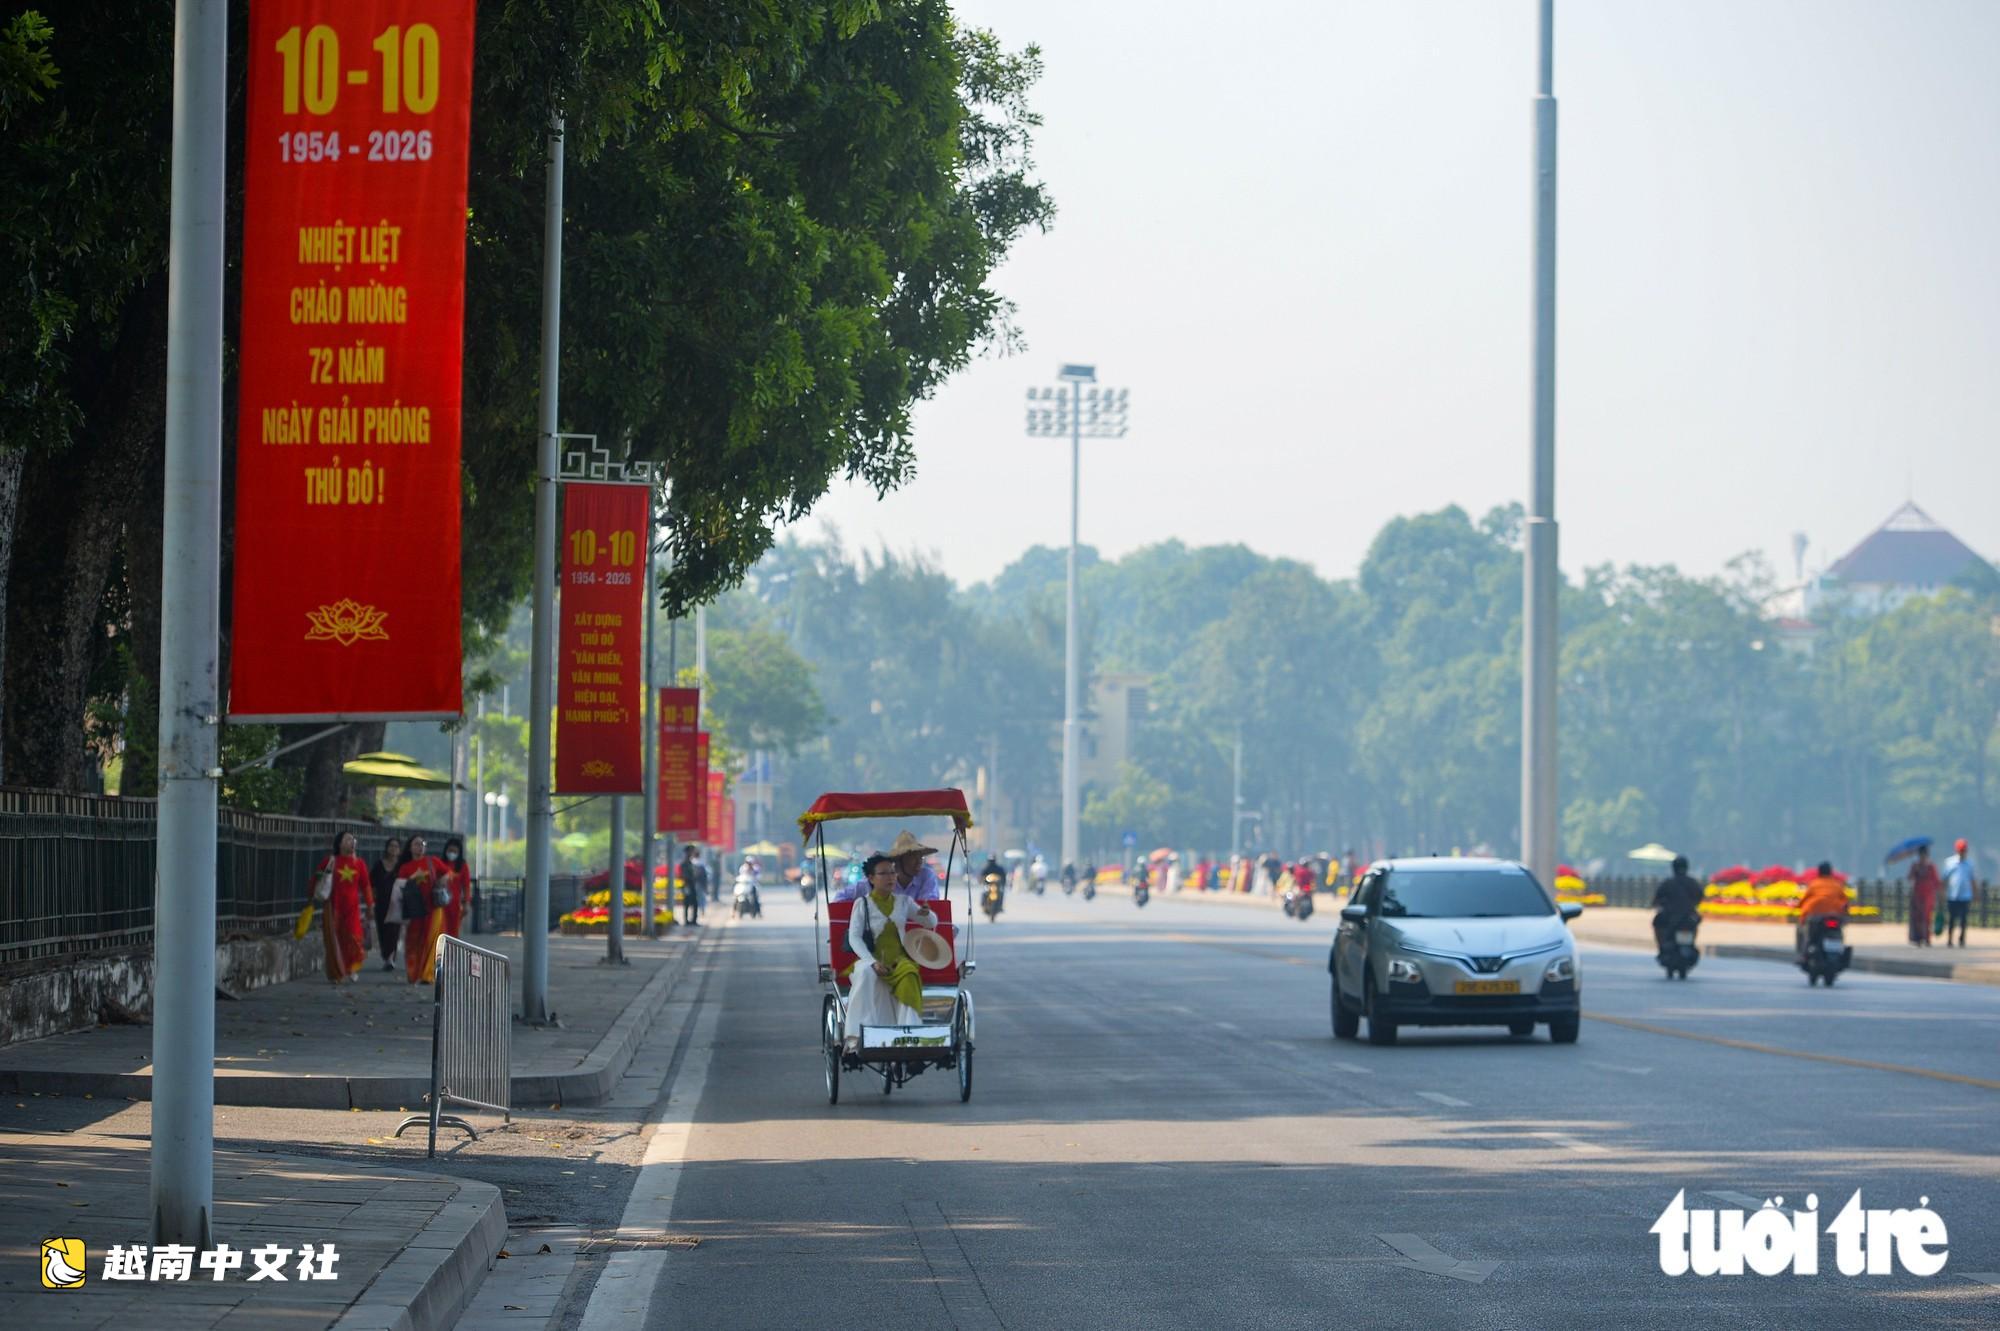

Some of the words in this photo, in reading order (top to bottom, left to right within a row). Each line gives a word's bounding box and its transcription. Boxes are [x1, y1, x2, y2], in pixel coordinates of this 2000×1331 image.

[279, 131, 340, 162] 1954
[367, 130, 432, 161] 2026
[299, 219, 355, 272] NHIỆT
[360, 219, 401, 272] LIỆT
[290, 279, 341, 324] CHÀO
[347, 279, 407, 324] MỪNG
[309, 347, 333, 384] 72
[338, 339, 384, 384] NĂM
[262, 400, 313, 445] NGÀY
[318, 395, 358, 444] GIẢI
[363, 399, 431, 444] PHÓNG
[305, 455, 342, 504] THỦ
[571, 571, 596, 584] 1954
[605, 572, 632, 585] 2026
